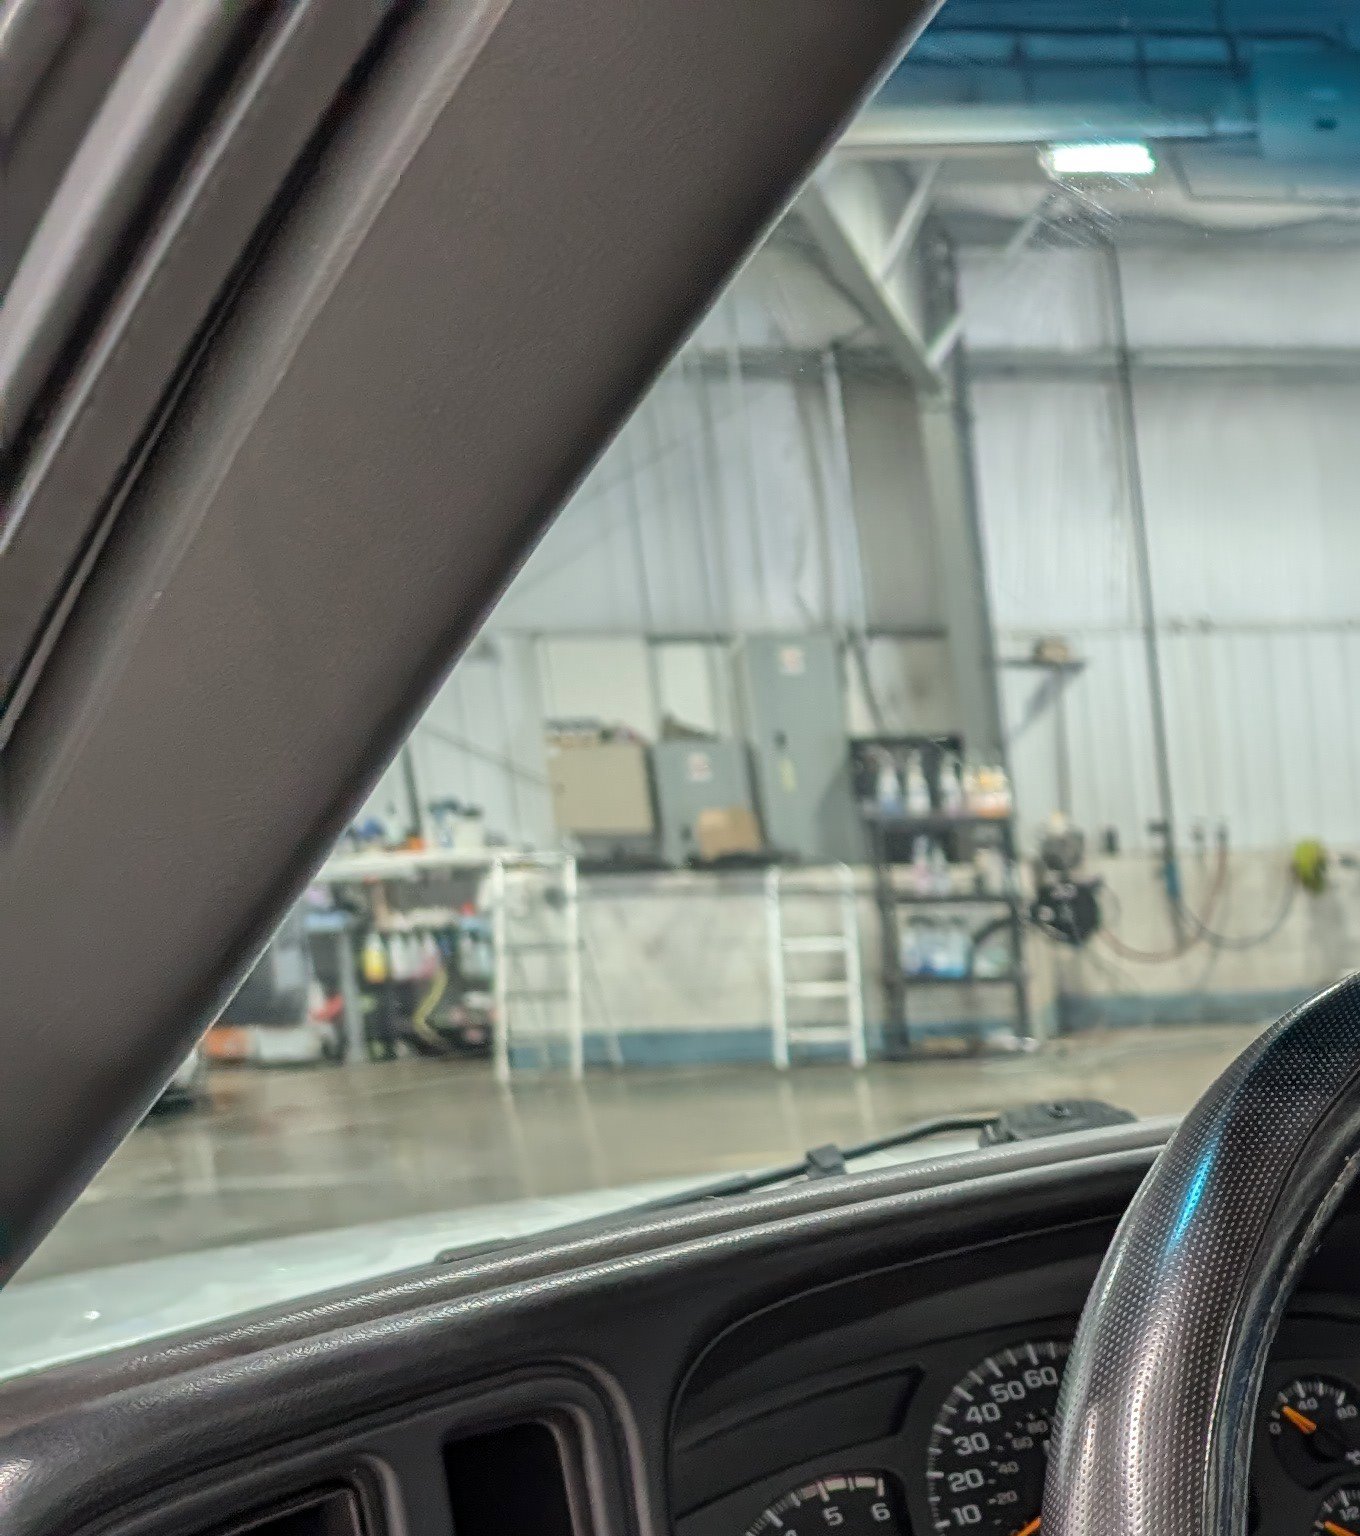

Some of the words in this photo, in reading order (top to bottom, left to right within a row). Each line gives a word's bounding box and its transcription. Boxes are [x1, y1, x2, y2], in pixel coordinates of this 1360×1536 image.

[1024, 1366, 1058, 1388] 60
[990, 1381, 1026, 1403] 50
[966, 1403, 1001, 1425] 40
[953, 1432, 990, 1456] 30
[948, 1469, 985, 1493] 20
[822, 1506, 844, 1526] 5
[871, 1502, 891, 1523] 6
[951, 1504, 982, 1526] 10
